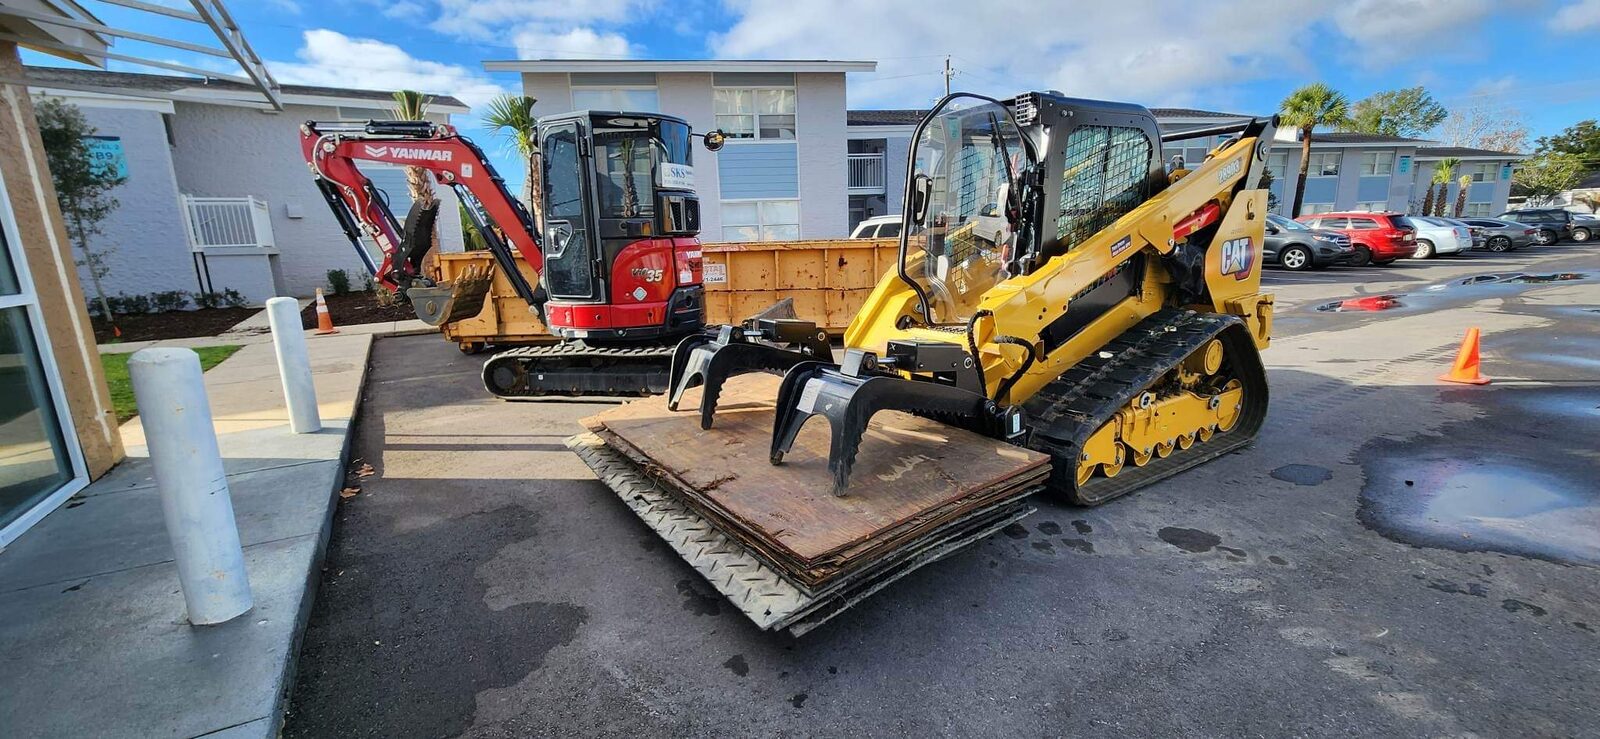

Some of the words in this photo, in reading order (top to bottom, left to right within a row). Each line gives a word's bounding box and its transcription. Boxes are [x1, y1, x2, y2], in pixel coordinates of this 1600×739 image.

[390, 147, 452, 161] YANMAR
[671, 167, 686, 178] SKS
[1221, 238, 1248, 275] CAT
